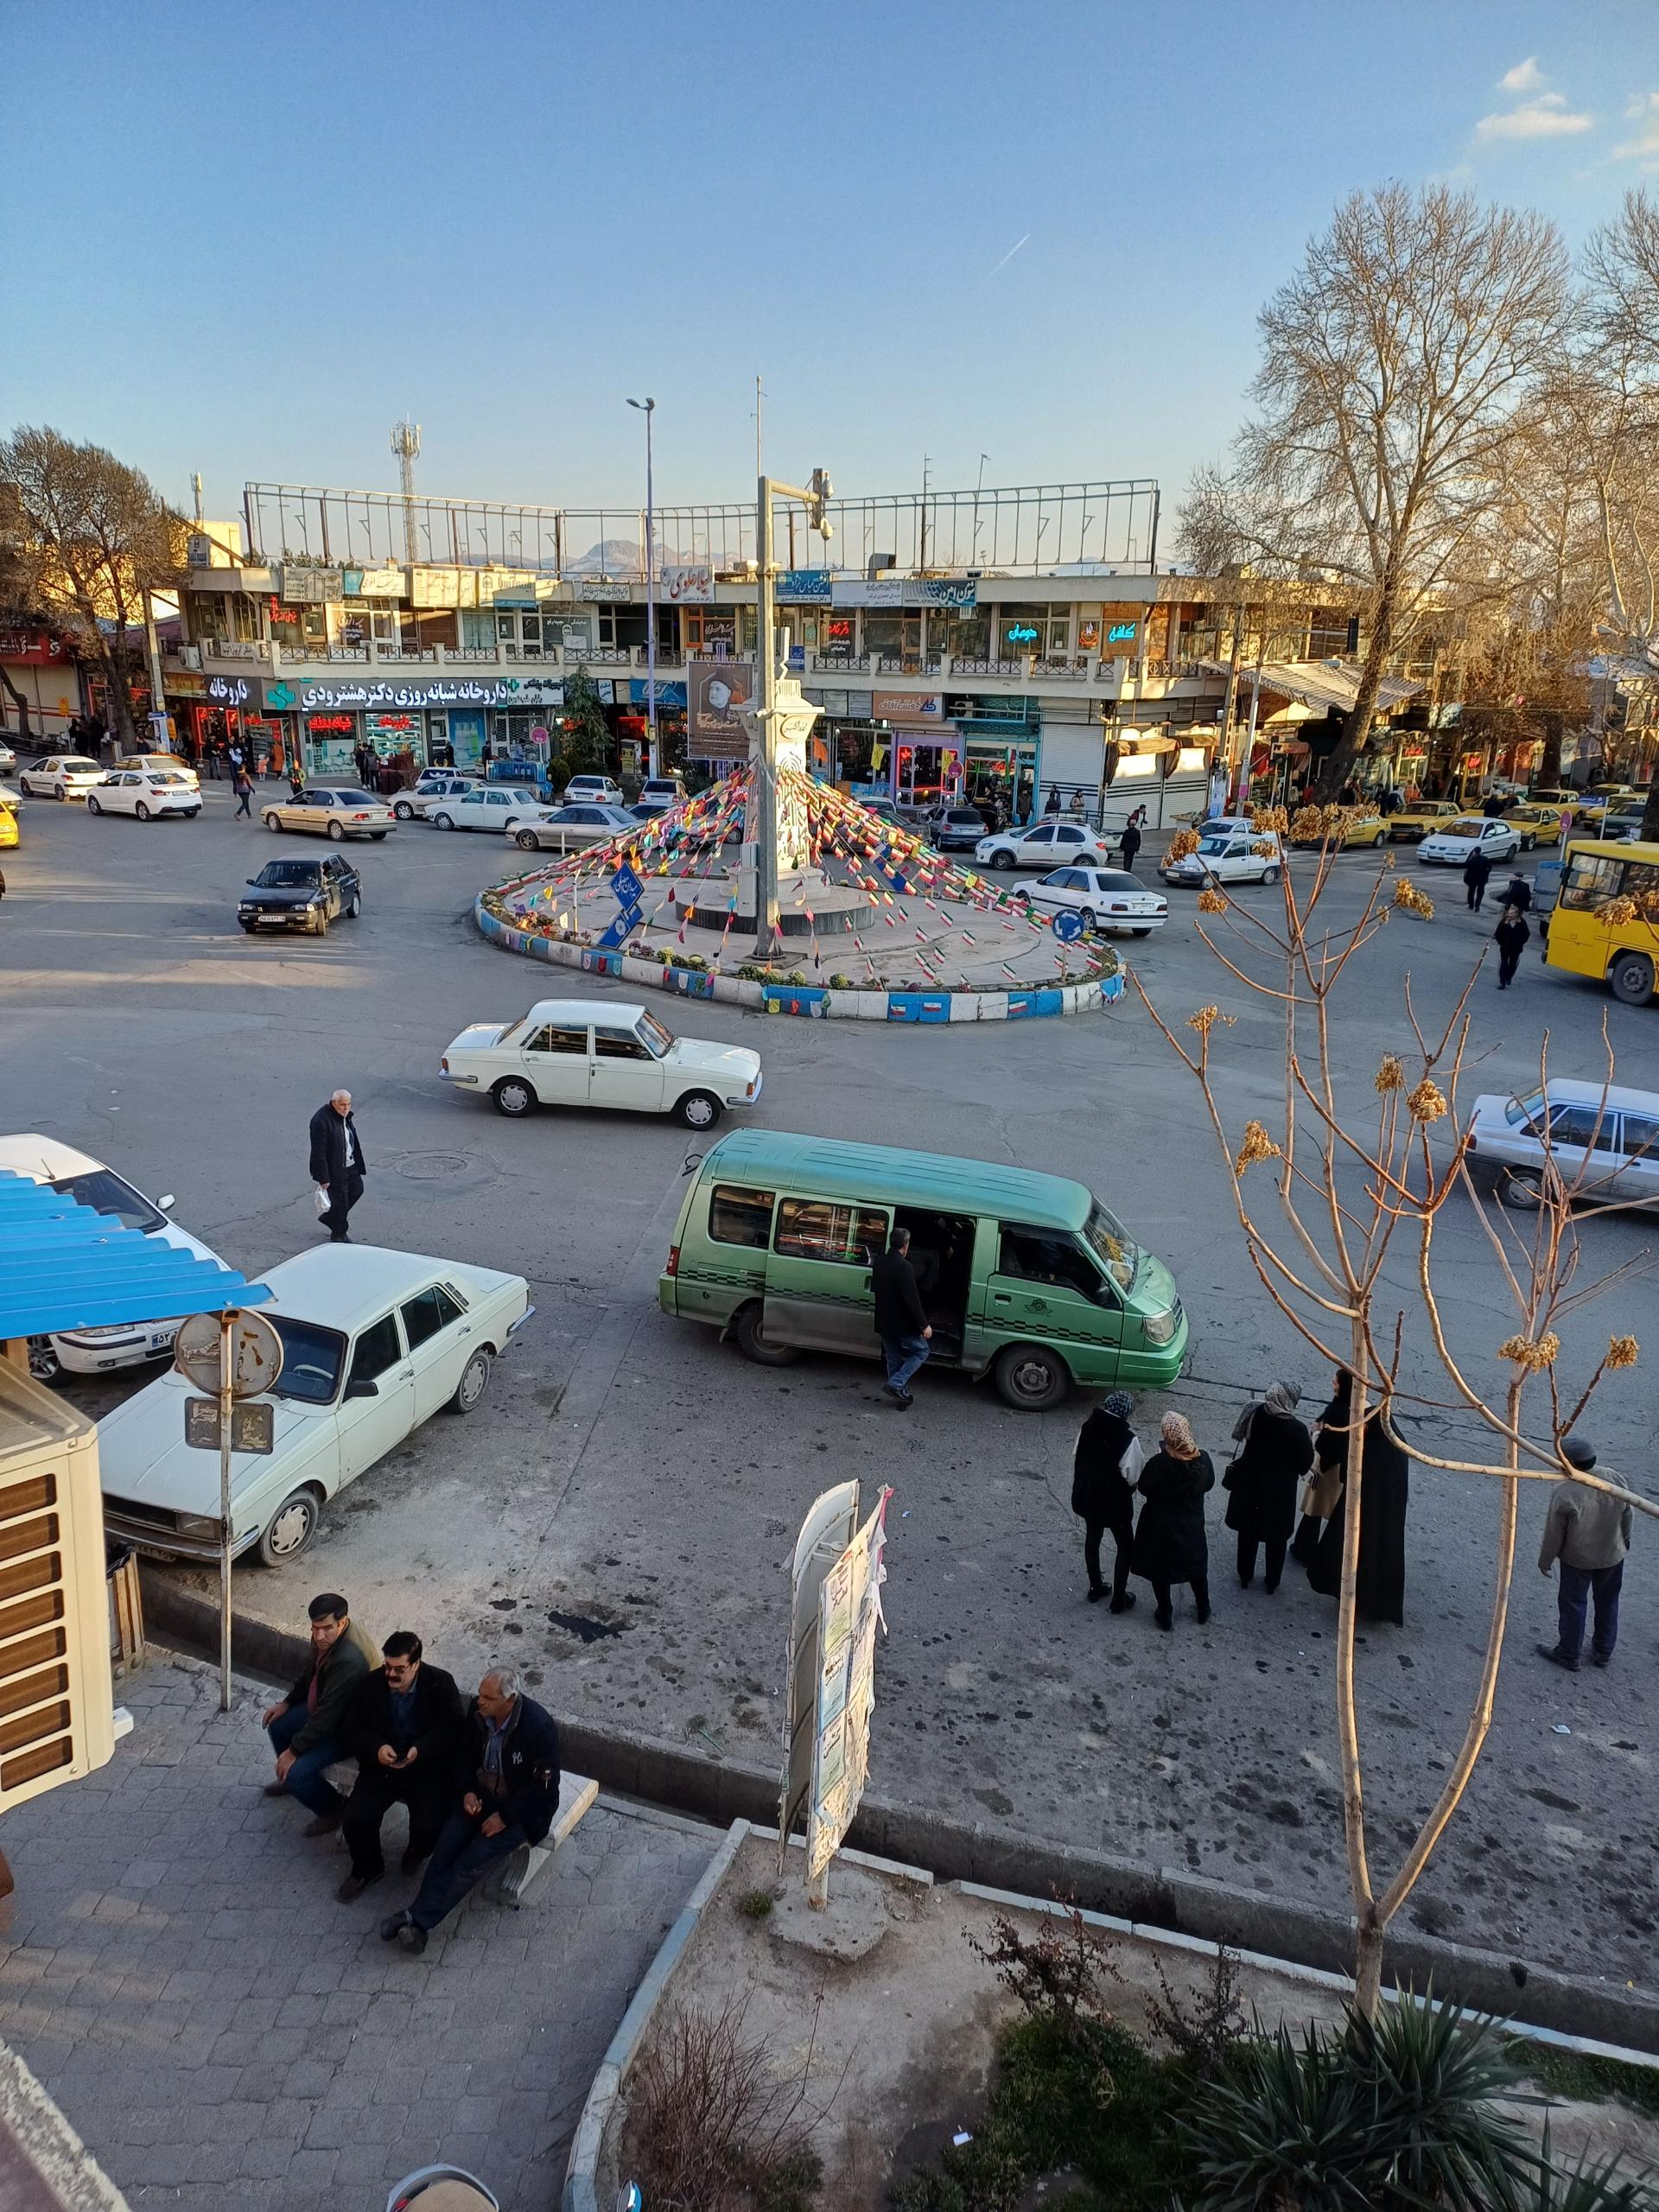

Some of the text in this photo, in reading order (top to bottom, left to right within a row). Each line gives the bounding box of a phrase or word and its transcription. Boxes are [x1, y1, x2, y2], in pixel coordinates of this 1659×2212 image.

[1108, 622, 1136, 643] کافه
[209, 677, 248, 705] داروخانه
[364, 682, 394, 708] دکتر
[395, 685, 428, 706] روزی
[427, 682, 458, 705] شبانه
[457, 681, 507, 705] داروخانه
